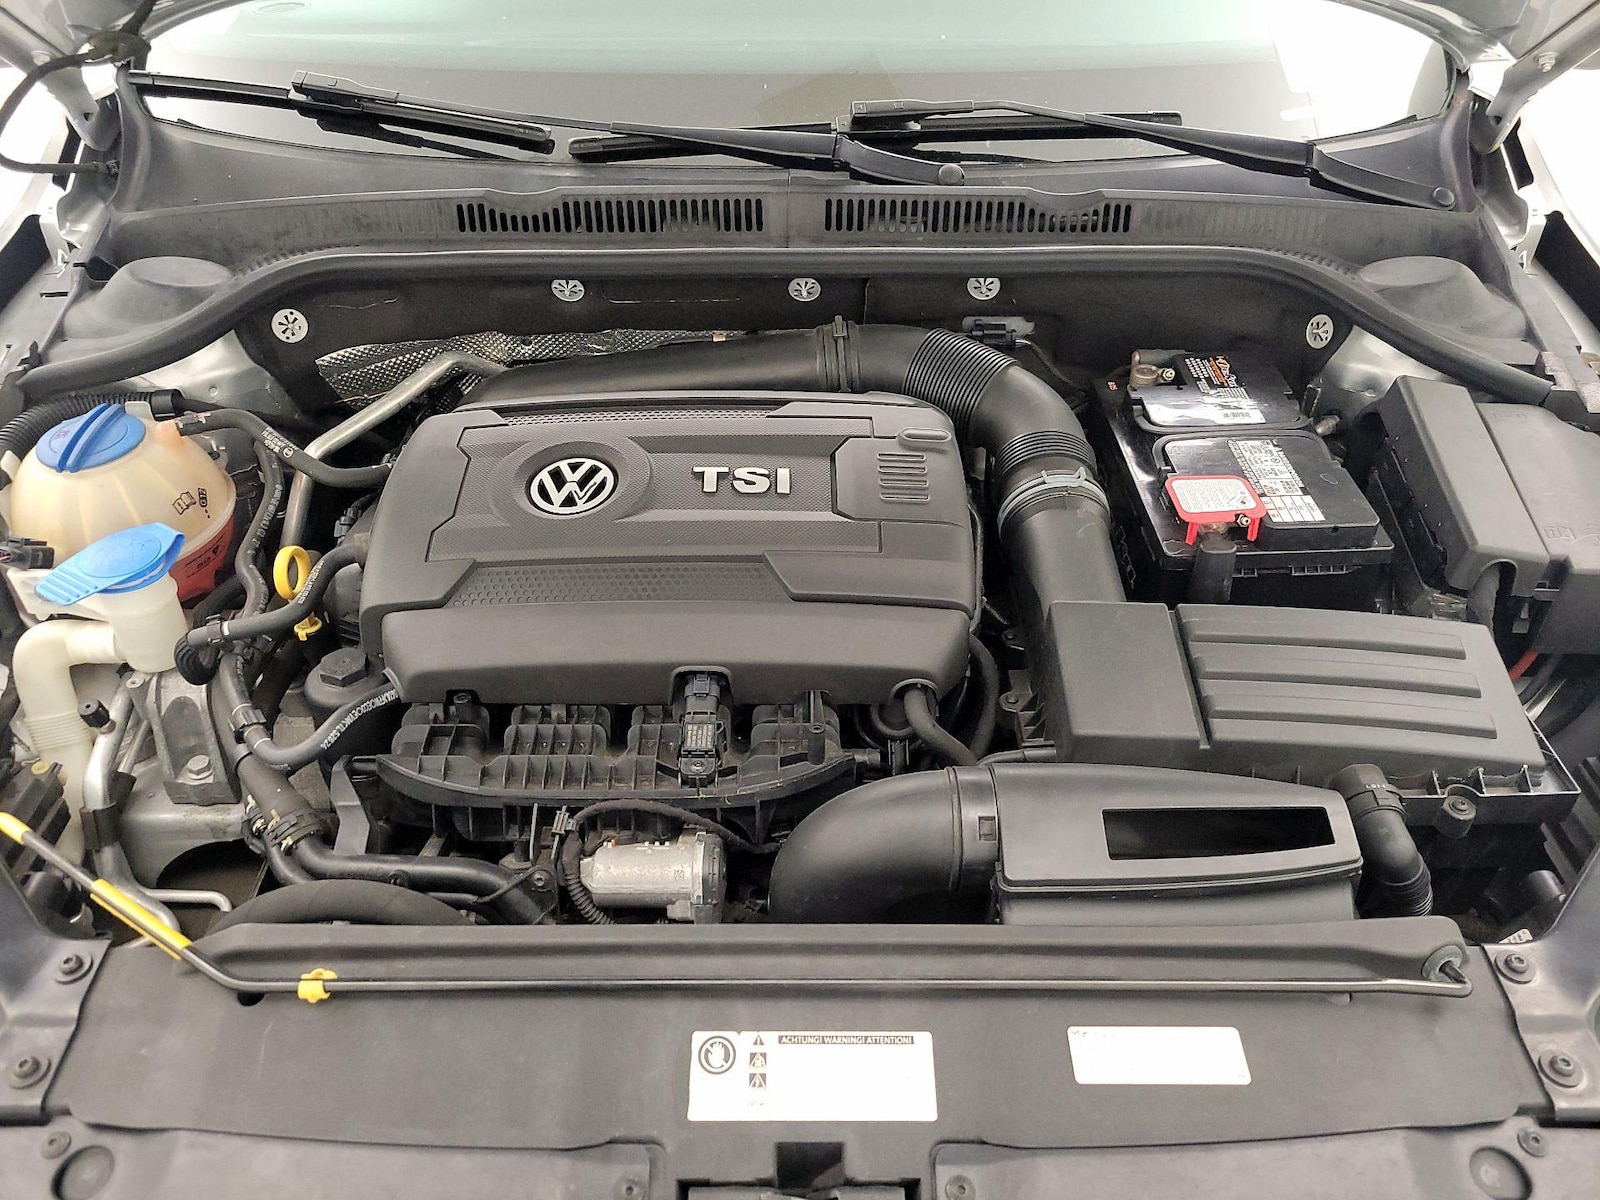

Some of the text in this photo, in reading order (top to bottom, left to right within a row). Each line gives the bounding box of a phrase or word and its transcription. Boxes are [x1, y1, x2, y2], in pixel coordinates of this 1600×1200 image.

[692, 466, 791, 495] TSI
[199, 489, 207, 507] G12
[781, 1035, 913, 1044] ACHTUNG! WARNING! ATTENTION!
